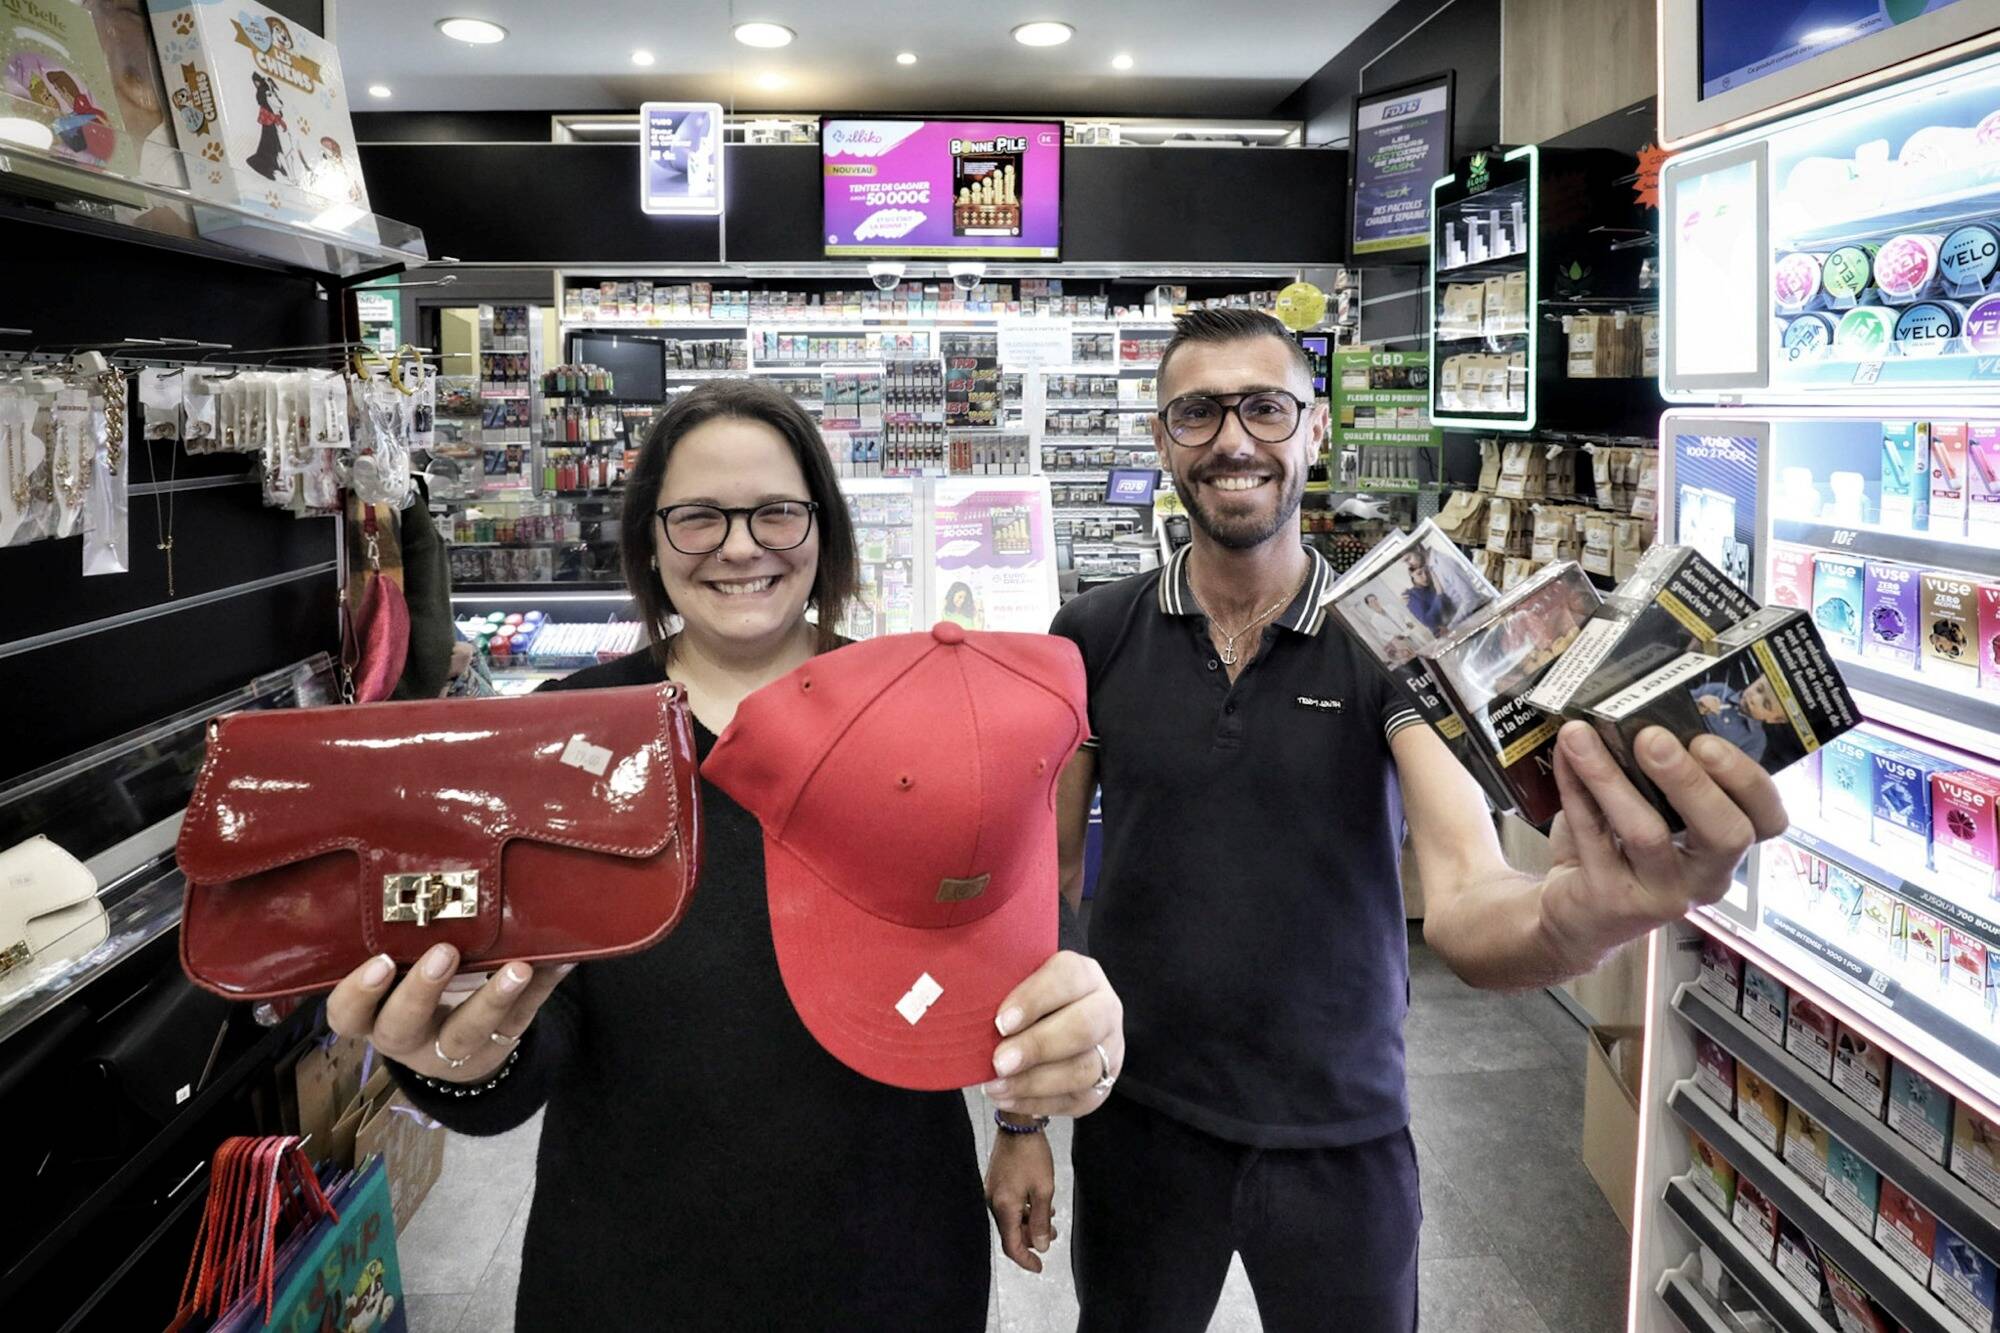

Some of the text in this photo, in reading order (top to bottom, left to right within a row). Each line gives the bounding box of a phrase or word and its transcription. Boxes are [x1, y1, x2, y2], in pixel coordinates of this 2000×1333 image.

[256, 51, 313, 92] CHIENS
[196, 73, 216, 120] CHIENS
[845, 129, 882, 144] illiko
[950, 137, 1027, 155] BONNE PILE
[832, 167, 873, 175] NOUVEAU
[849, 181, 930, 192] TENTEZ DE GAGNER
[1387, 199, 1424, 212] PACTOLES
[1394, 209, 1426, 222] SEMAINE
[1942, 242, 1997, 268] VELO
[1832, 254, 1859, 292] VELO
[1899, 323, 1950, 340] VELO
[1789, 324, 1823, 359] VELO
[1371, 354, 1404, 366] CBD
[1347, 394, 1374, 402] FLEURS
[1375, 394, 1391, 402] CBD
[1343, 432, 1374, 441] QUALITÉ
[1382, 432, 1430, 442] TRAÇABILITÉ
[1690, 556, 1720, 584] Fumer
[1718, 582, 1740, 602] nuit
[1736, 597, 1746, 609] à
[1878, 581, 1900, 591] ZERO
[1670, 580, 1712, 617] gencives
[1681, 568, 1741, 624] dents et à vos
[1935, 593, 1960, 604] ZERO
[1642, 655, 1707, 692] Fumer
[1773, 635, 1817, 710] devenir fumeurs
[1785, 628, 1840, 727] ont plus de risques de
[1795, 621, 1854, 726] Les enfants de fumeurs
[1418, 693, 1440, 709] la
[1605, 693, 1640, 713] tue
[1503, 720, 1517, 734] la
[1515, 708, 1538, 727] bou
[1956, 910, 1974, 923] 700
[1846, 959, 1863, 974] POD
